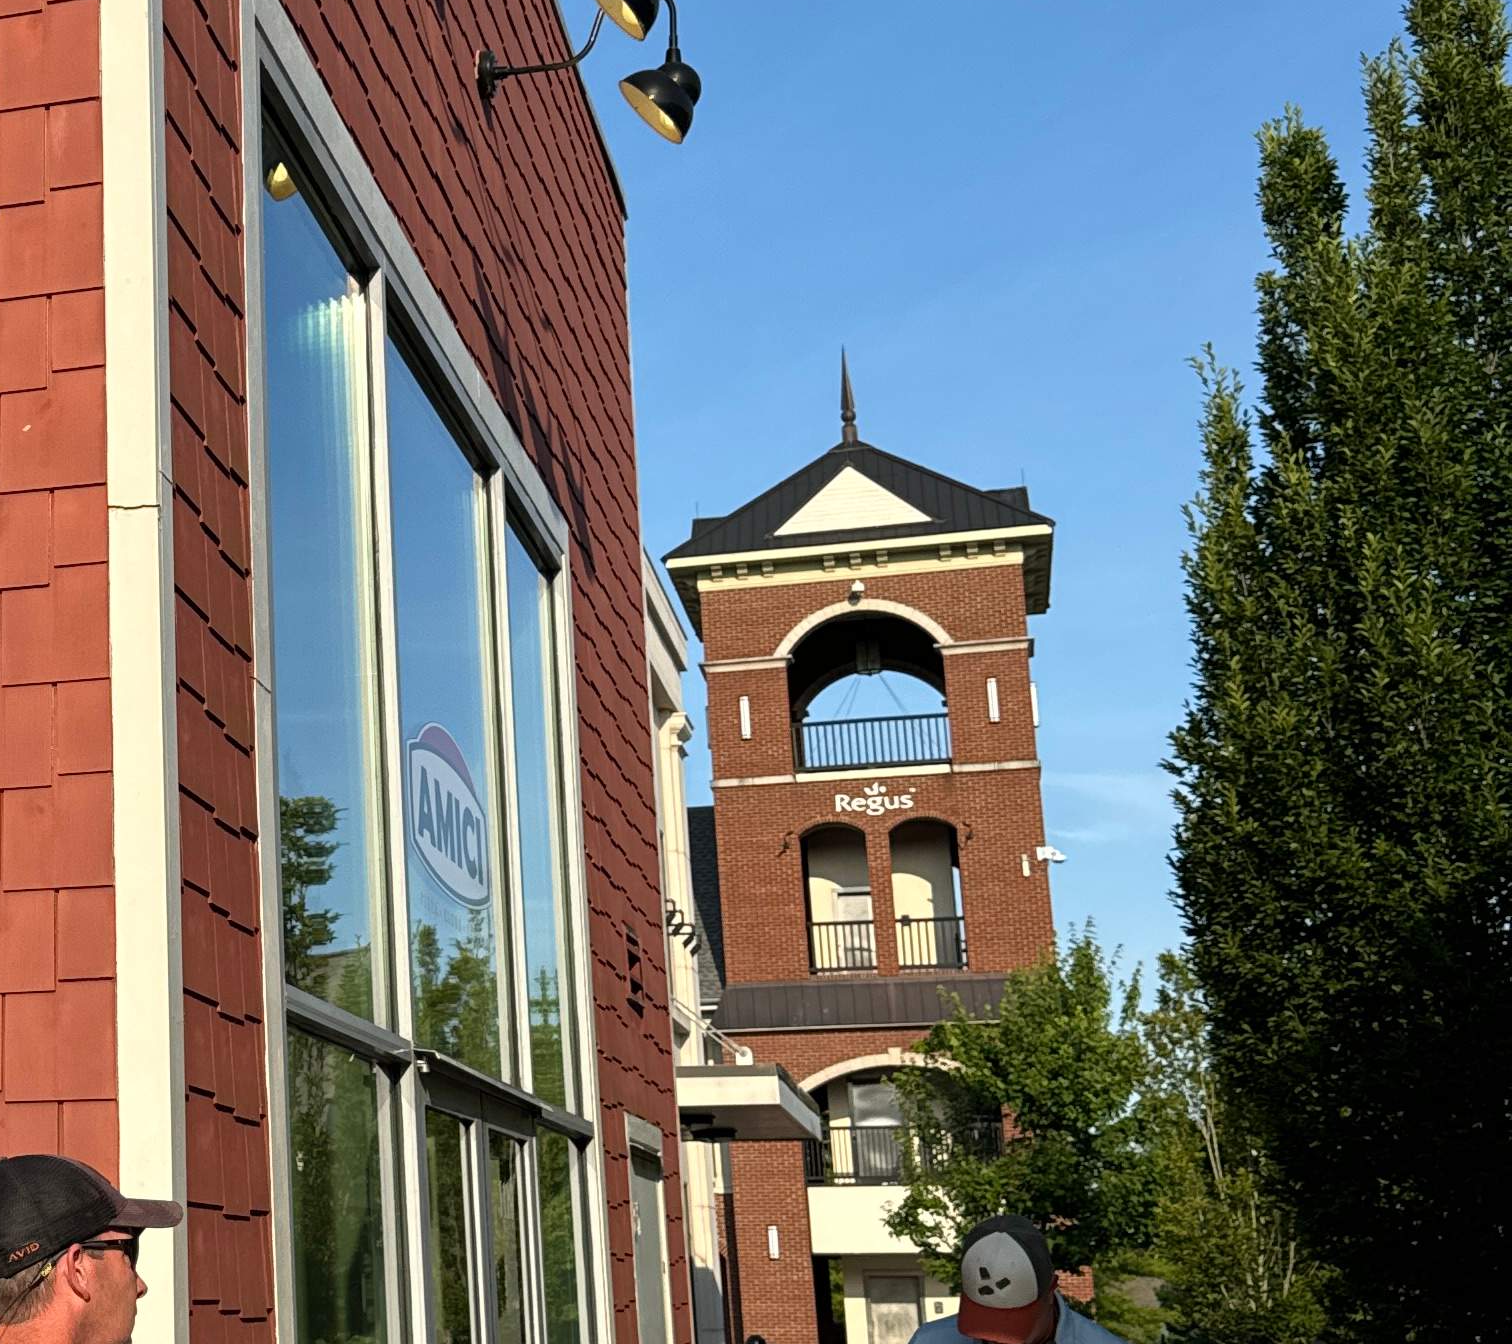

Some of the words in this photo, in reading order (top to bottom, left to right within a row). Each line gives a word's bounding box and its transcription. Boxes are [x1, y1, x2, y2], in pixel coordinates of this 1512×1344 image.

[834, 794, 914, 816] Regus
[418, 765, 484, 886] AMICI
[8, 1242, 40, 1263] AVID
